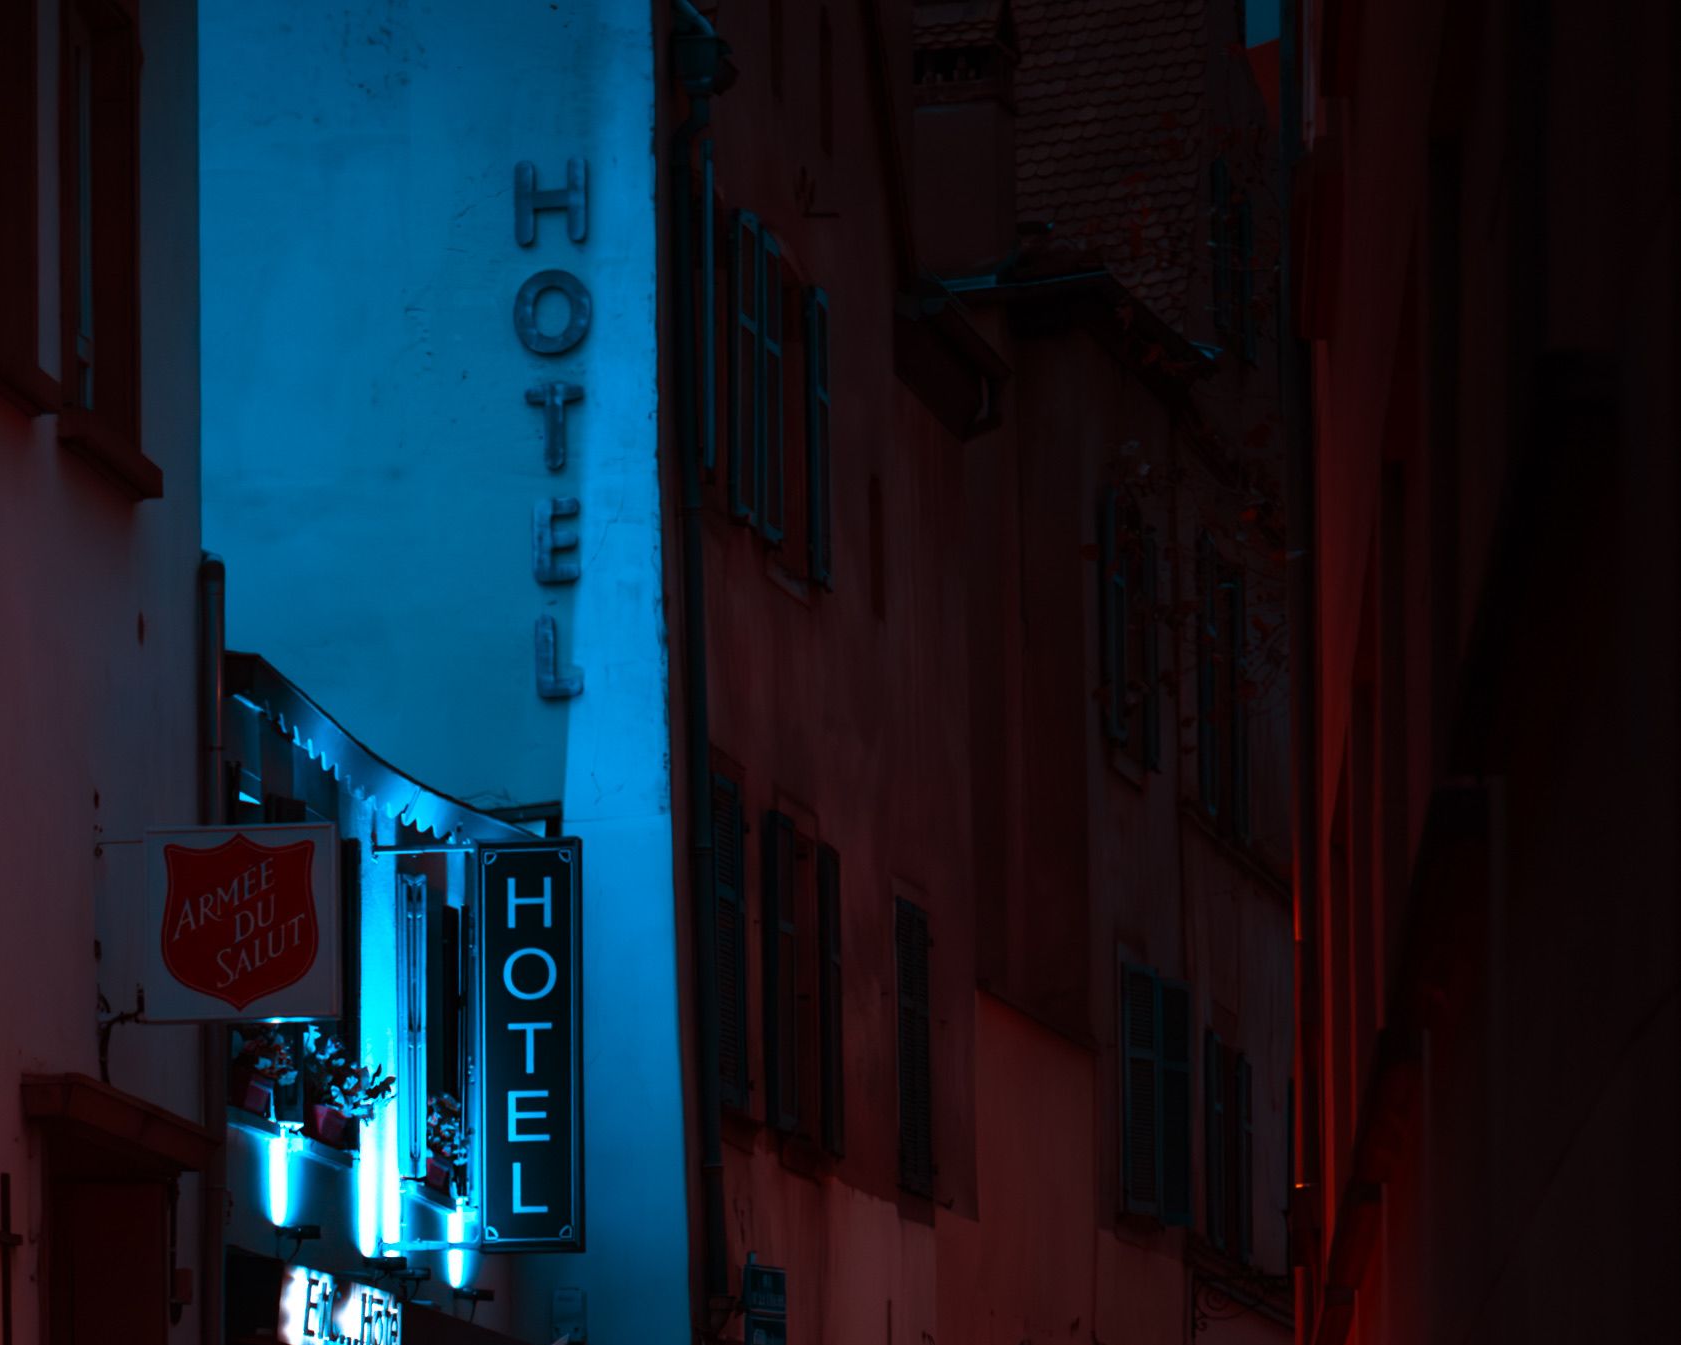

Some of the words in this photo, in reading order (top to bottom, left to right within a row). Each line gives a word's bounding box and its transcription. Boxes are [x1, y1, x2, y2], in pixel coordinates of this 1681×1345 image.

[513, 155, 593, 702] HOTEL
[216, 913, 305, 988] SALUT
[234, 894, 276, 945] DU
[502, 876, 559, 1214] HOTEL
